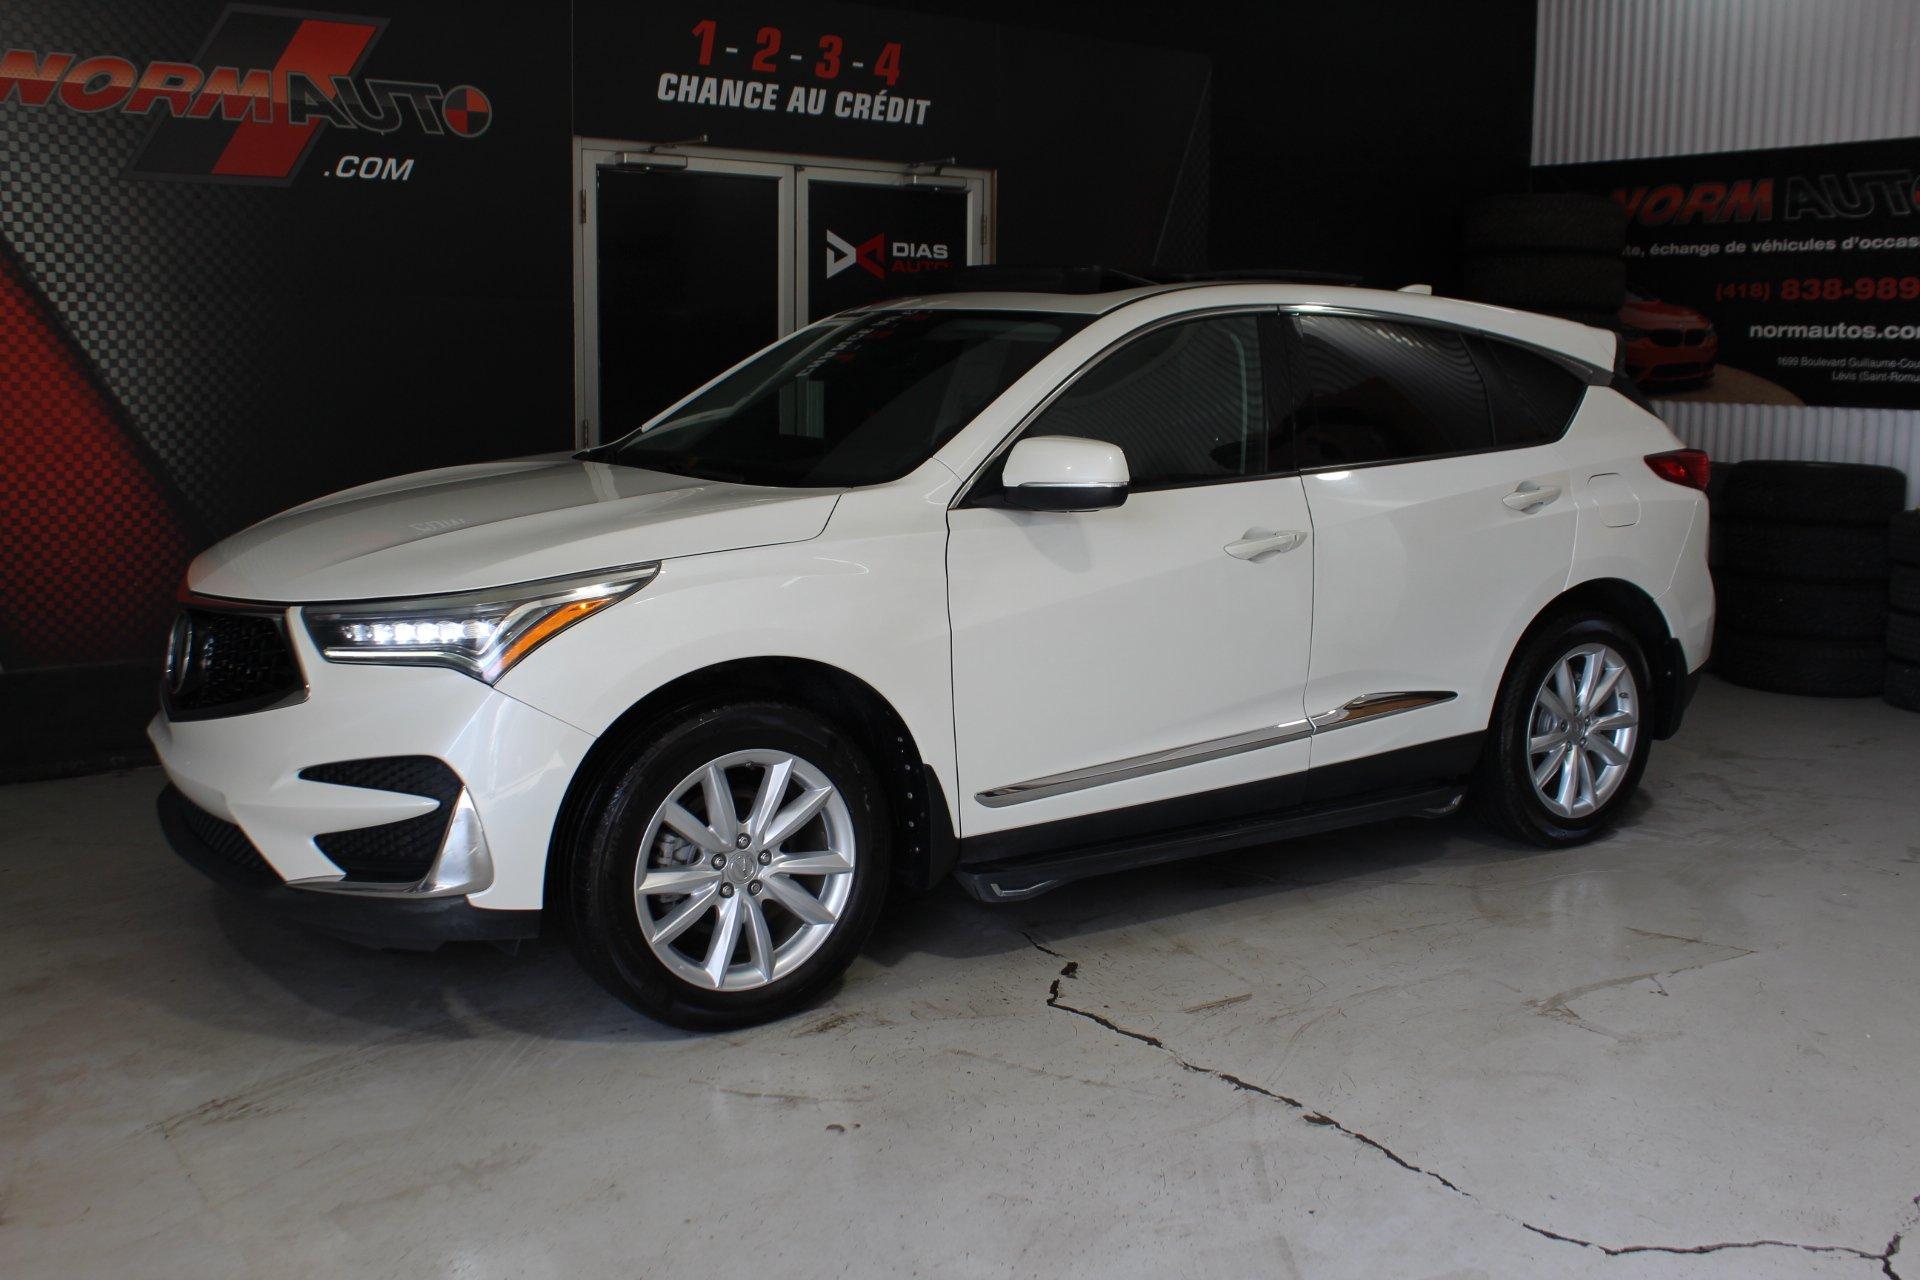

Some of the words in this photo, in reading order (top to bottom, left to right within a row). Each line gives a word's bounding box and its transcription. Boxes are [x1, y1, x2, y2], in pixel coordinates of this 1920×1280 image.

[657, 72, 780, 112] CHANCE
[786, 86, 827, 116] AU
[834, 89, 931, 126] CRÉDIT
[323, 155, 415, 181] .COM
[1783, 169, 1920, 221] AUT
[892, 241, 949, 260] DIAS
[1649, 242, 1720, 258] échange
[1724, 240, 1747, 253] de
[1751, 237, 1837, 254] véhicules
[1749, 322, 1920, 340] normautos.co
